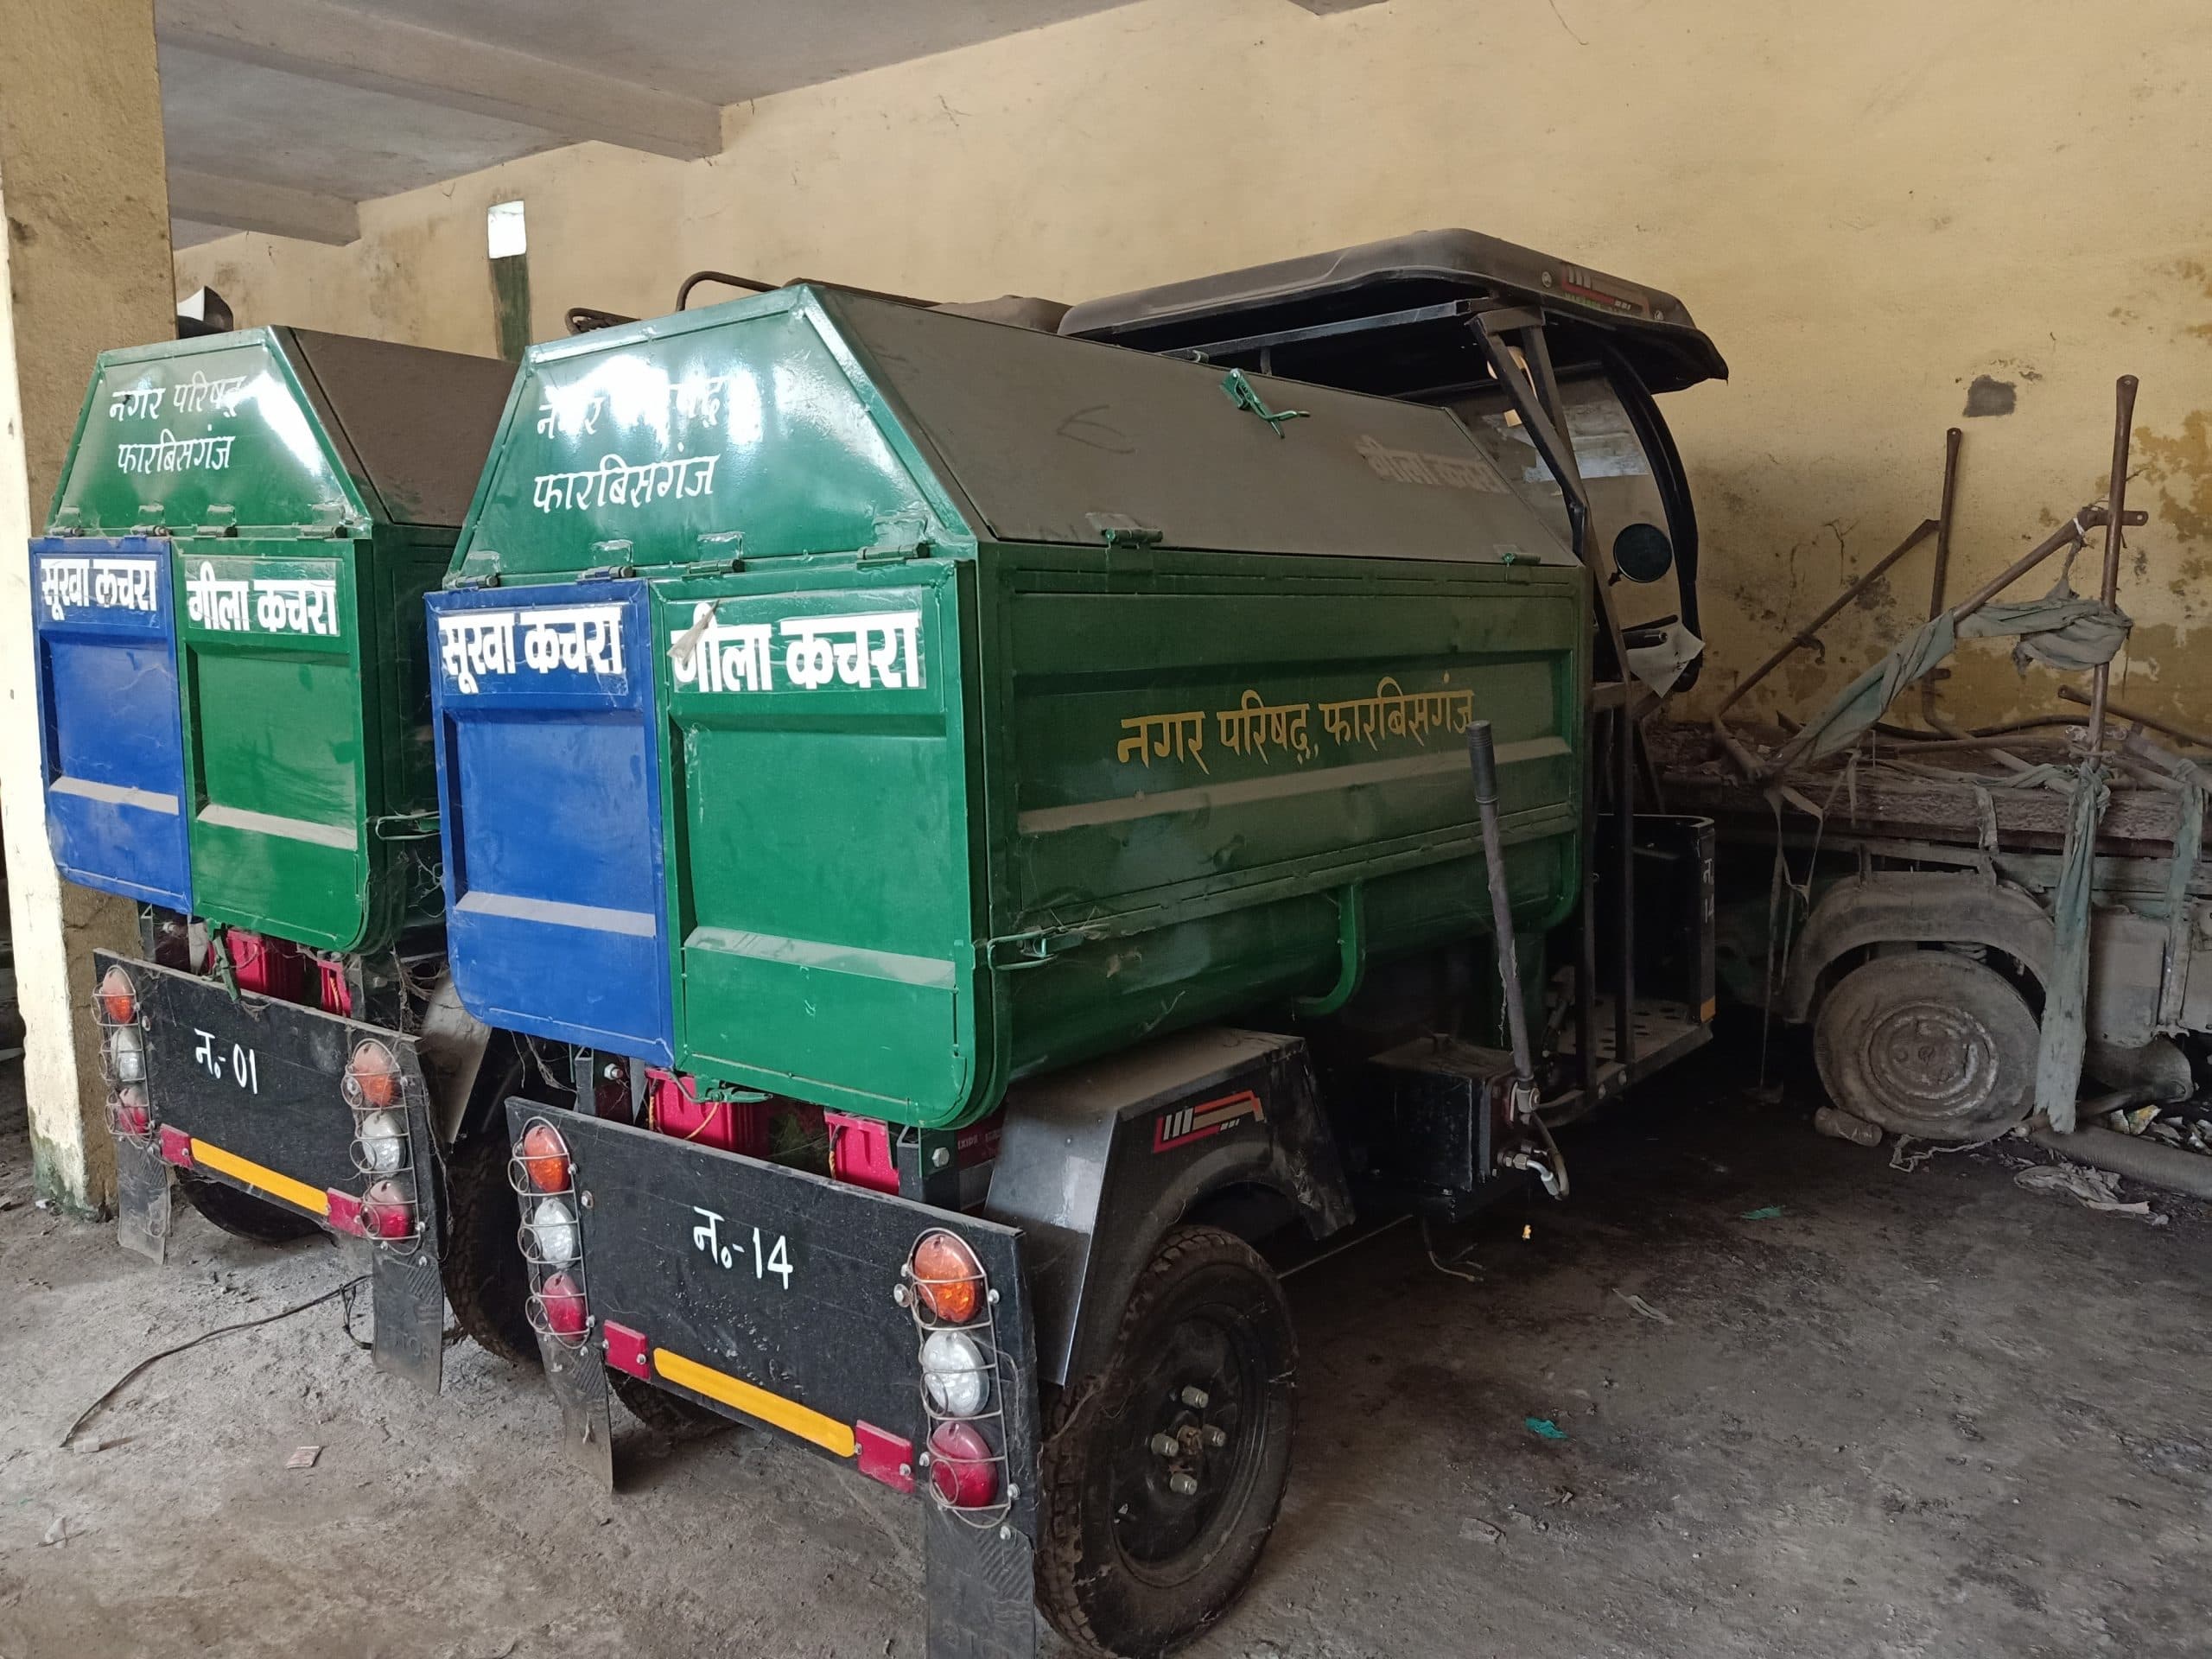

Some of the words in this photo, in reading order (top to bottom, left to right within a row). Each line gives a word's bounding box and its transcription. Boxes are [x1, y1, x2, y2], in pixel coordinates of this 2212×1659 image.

[110, 387, 166, 422] नगर
[118, 423, 236, 474] फारबिसगंज
[533, 442, 721, 513] फारबिसगंज
[41, 558, 90, 620] सूखा
[92, 558, 157, 611] कचरा
[186, 561, 250, 631] गीला
[254, 580, 338, 635] कचरा
[438, 613, 516, 694] सूखा
[520, 607, 622, 674] कचरा
[780, 612, 919, 690] कचरा
[1117, 711, 1210, 774] नगर
[1319, 671, 1474, 751] फारबिसगंज
